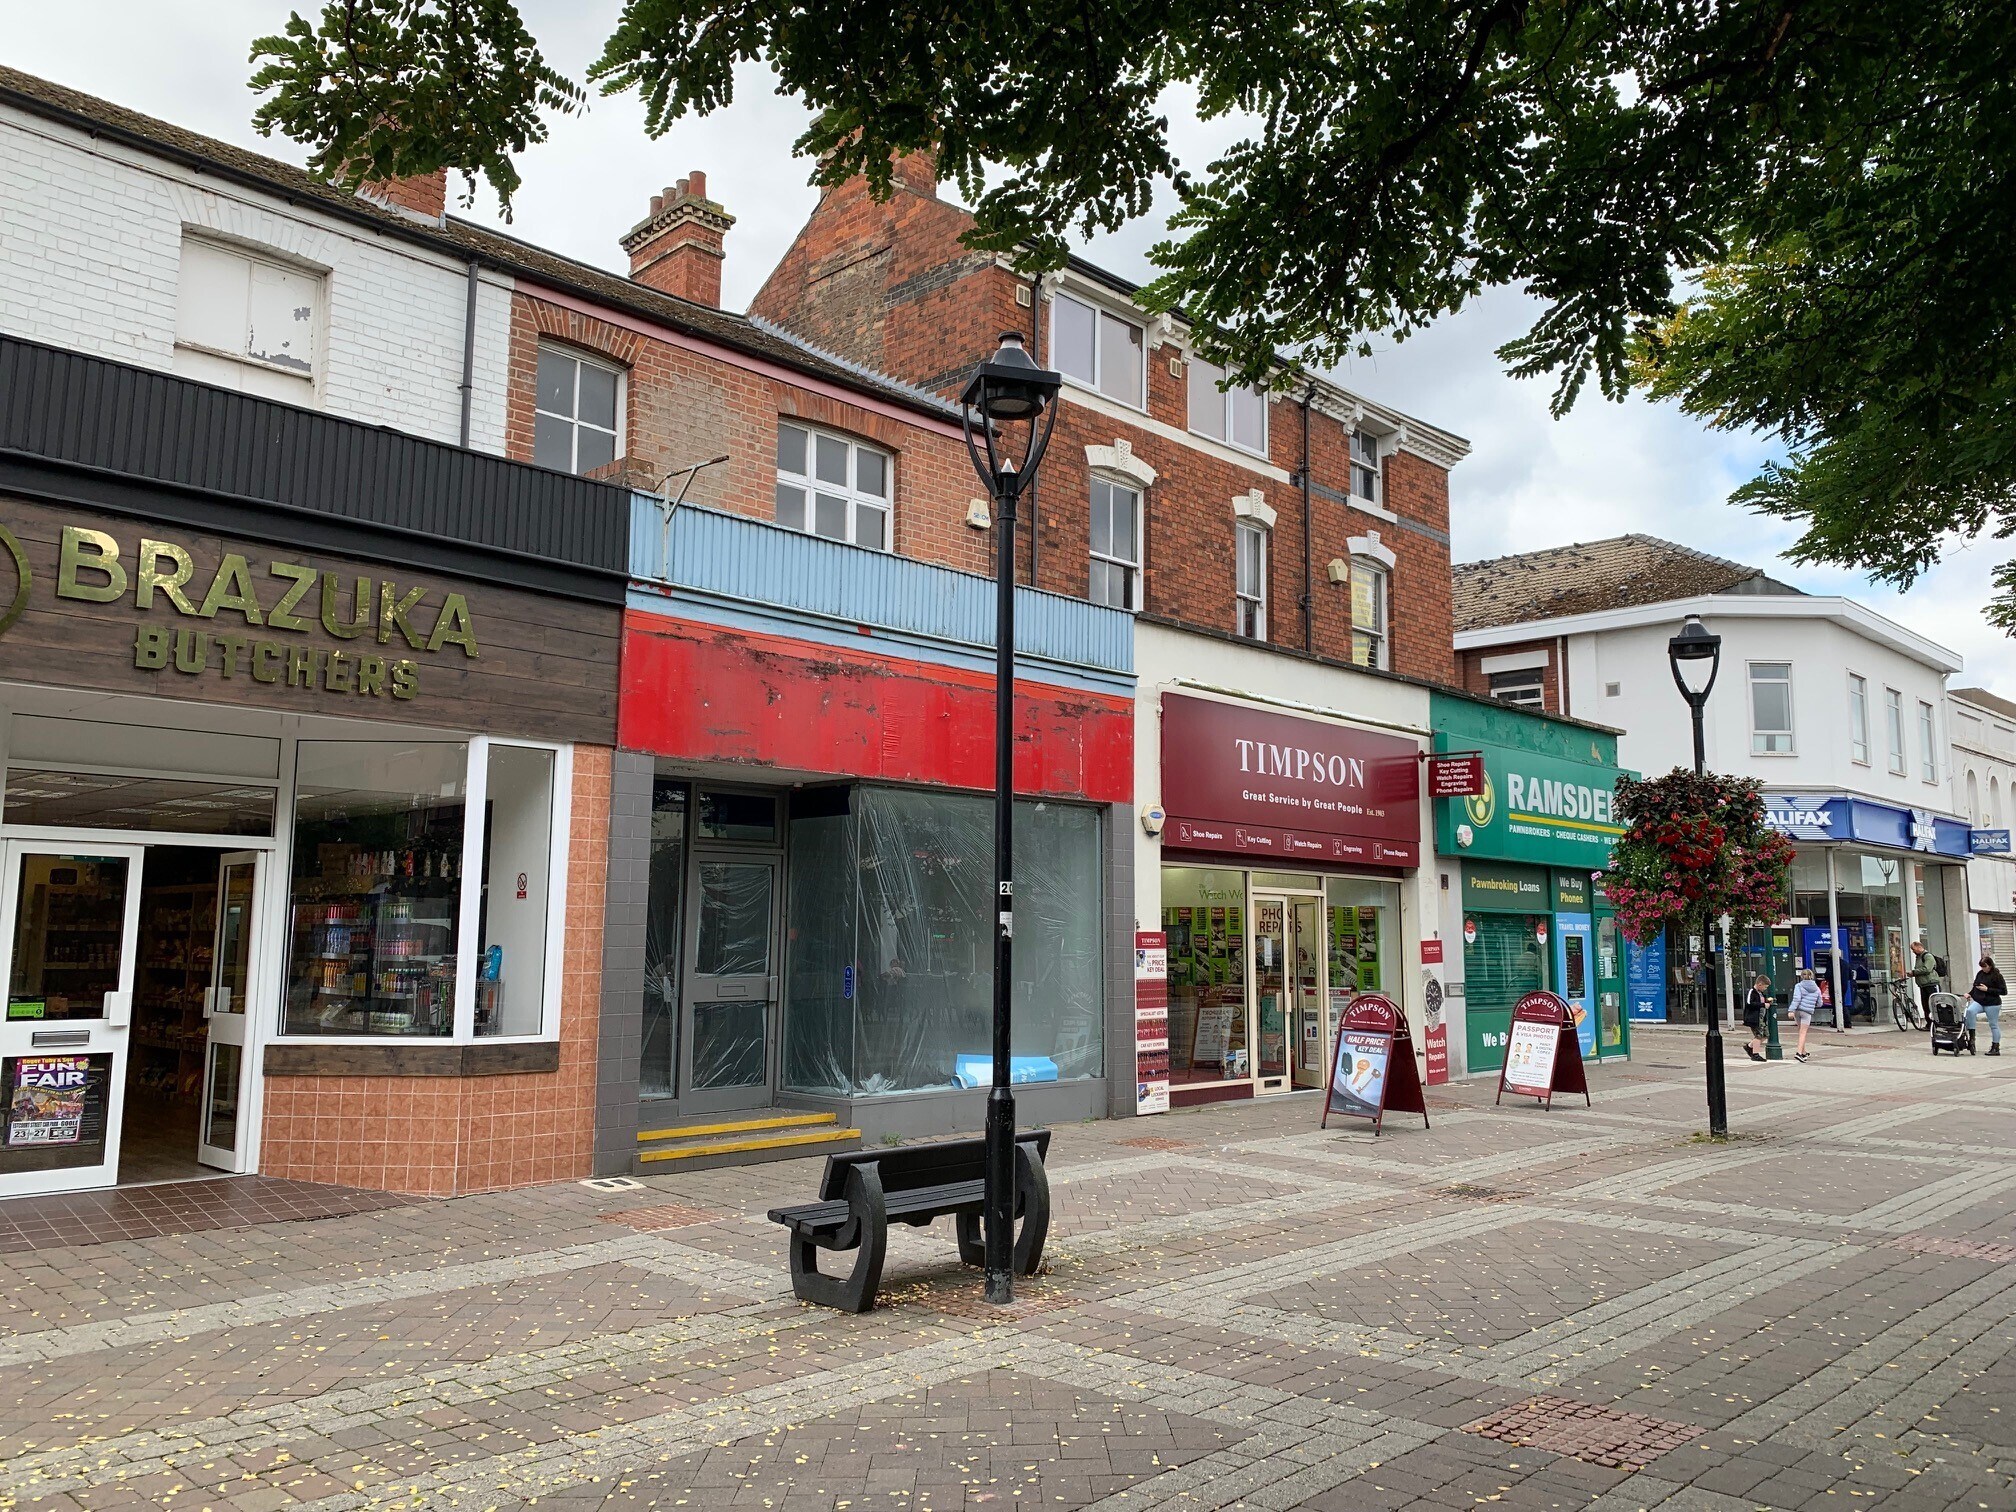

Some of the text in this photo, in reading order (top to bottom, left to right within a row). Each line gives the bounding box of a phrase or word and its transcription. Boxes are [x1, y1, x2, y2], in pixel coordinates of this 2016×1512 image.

[57, 525, 479, 658] BRAZUKA
[134, 625, 420, 699] BUTCHERS
[1235, 738, 1365, 789] TIMPSON
[1242, 790, 1266, 802] Great
[1269, 792, 1300, 806] Service
[1302, 797, 1311, 809] by
[1313, 798, 1335, 811] Great
[1337, 801, 1363, 815] People
[1507, 773, 1636, 827] RAMSDE
[1762, 810, 1833, 826] ALIFAX
[1193, 830, 1223, 840] Shoe Repairs
[1509, 825, 1551, 838] PAWNBROKERS
[1556, 830, 1577, 841] CHEQUE
[1577, 833, 1599, 844] CASHERS
[1912, 824, 1936, 840] HALIFAX
[1256, 837, 1272, 846] Cutting
[1294, 840, 1323, 849] Watch Repairs
[1972, 837, 2008, 845] HALIFAX
[1343, 845, 1362, 854] Engraving
[1471, 877, 1540, 893] Pawnbroking Loans
[1559, 877, 1583, 891] We Buy
[1560, 892, 1583, 904] Phones
[1349, 1003, 1391, 1020] TIMPSON
[1521, 998, 1558, 1013] TIMPSON
[1517, 1024, 1555, 1035] PASSPORT
[1347, 1035, 1386, 1046] HALF PRICE
[1427, 1038, 1446, 1049] Watch
[1482, 1032, 1498, 1047] We
[1428, 1053, 1446, 1062] Repairs
[22, 1062, 75, 1073] FUN
[21, 1072, 84, 1088] FAIR
